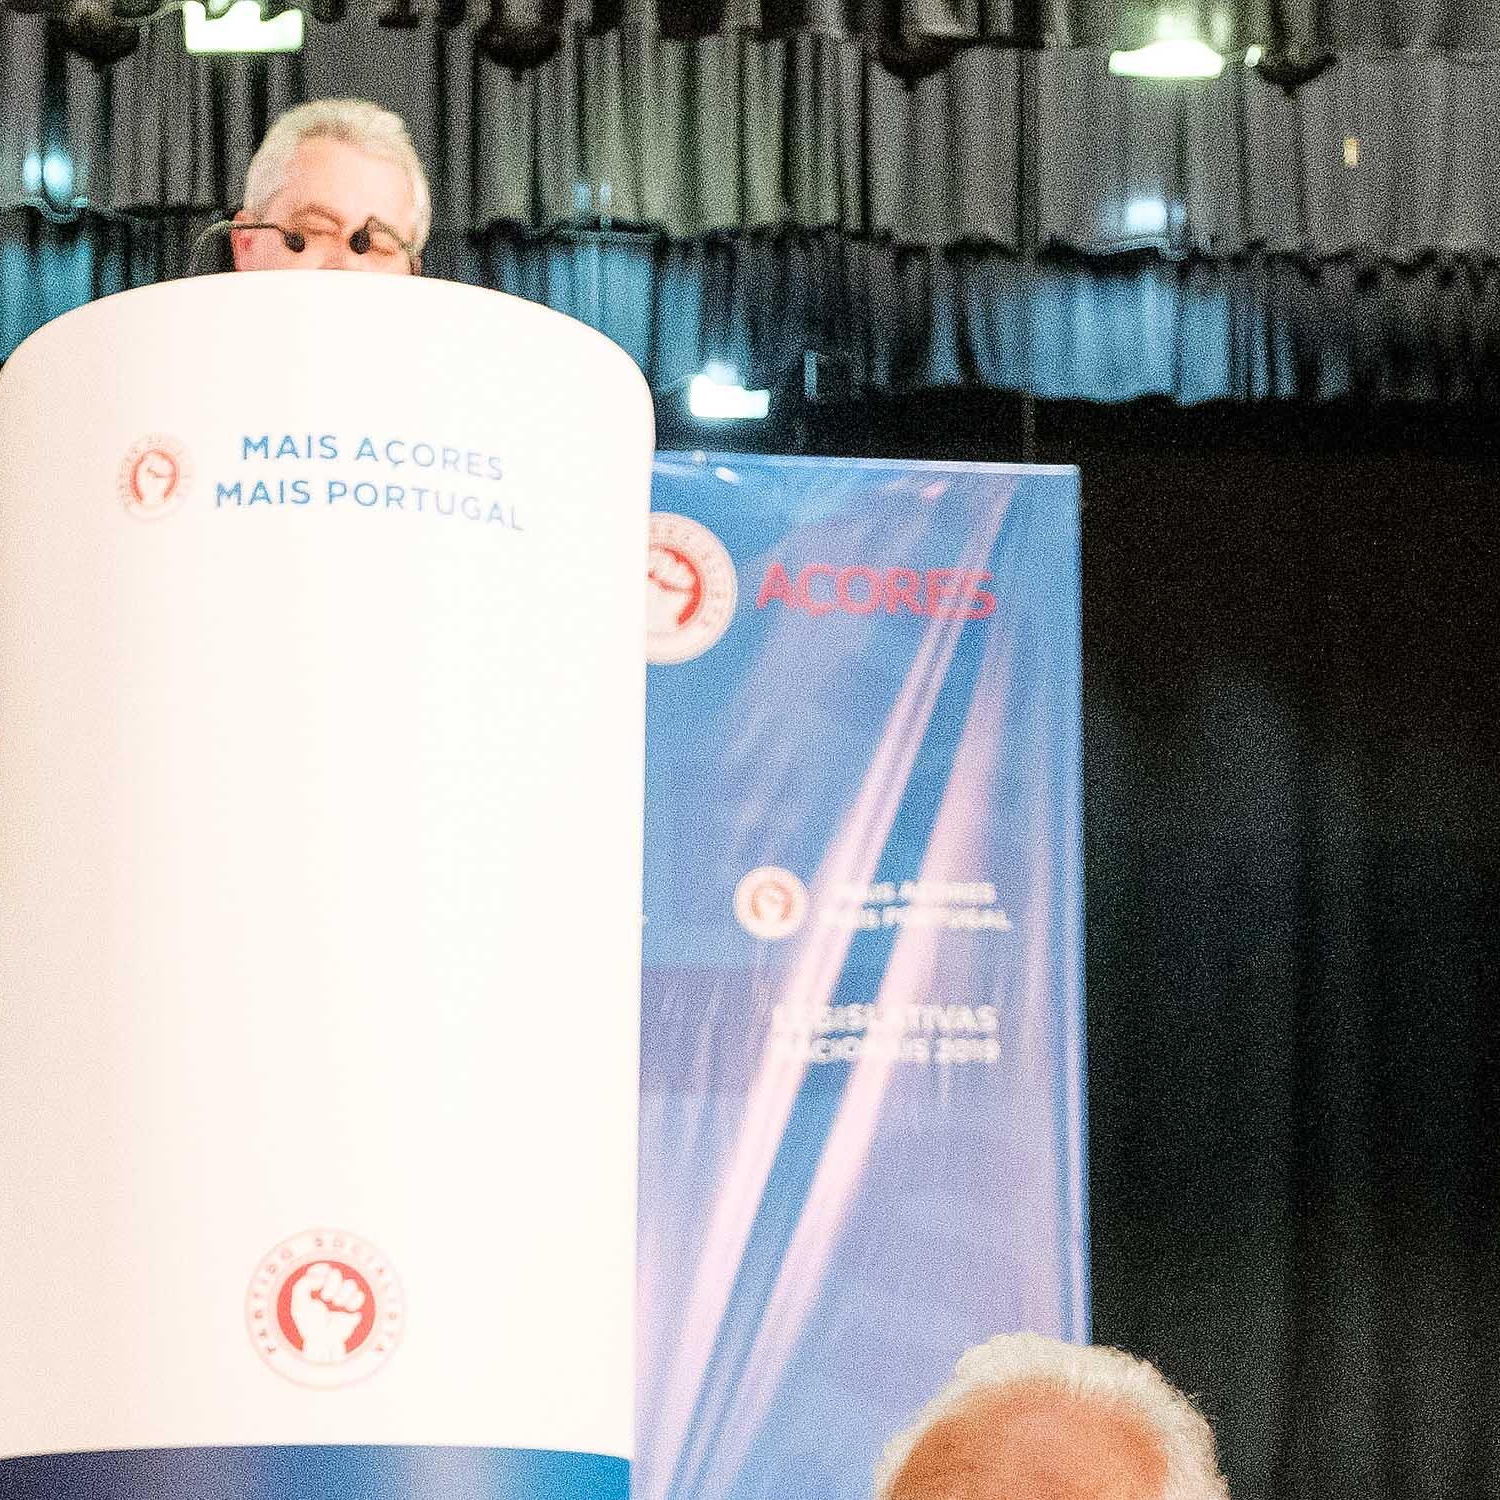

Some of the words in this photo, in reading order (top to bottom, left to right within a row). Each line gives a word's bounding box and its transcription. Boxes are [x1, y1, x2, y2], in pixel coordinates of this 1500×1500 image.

[242, 434, 338, 460] MAIS
[354, 436, 505, 482] AÇORES
[215, 479, 311, 508] MAIS
[327, 480, 525, 532] PORTUGAL
